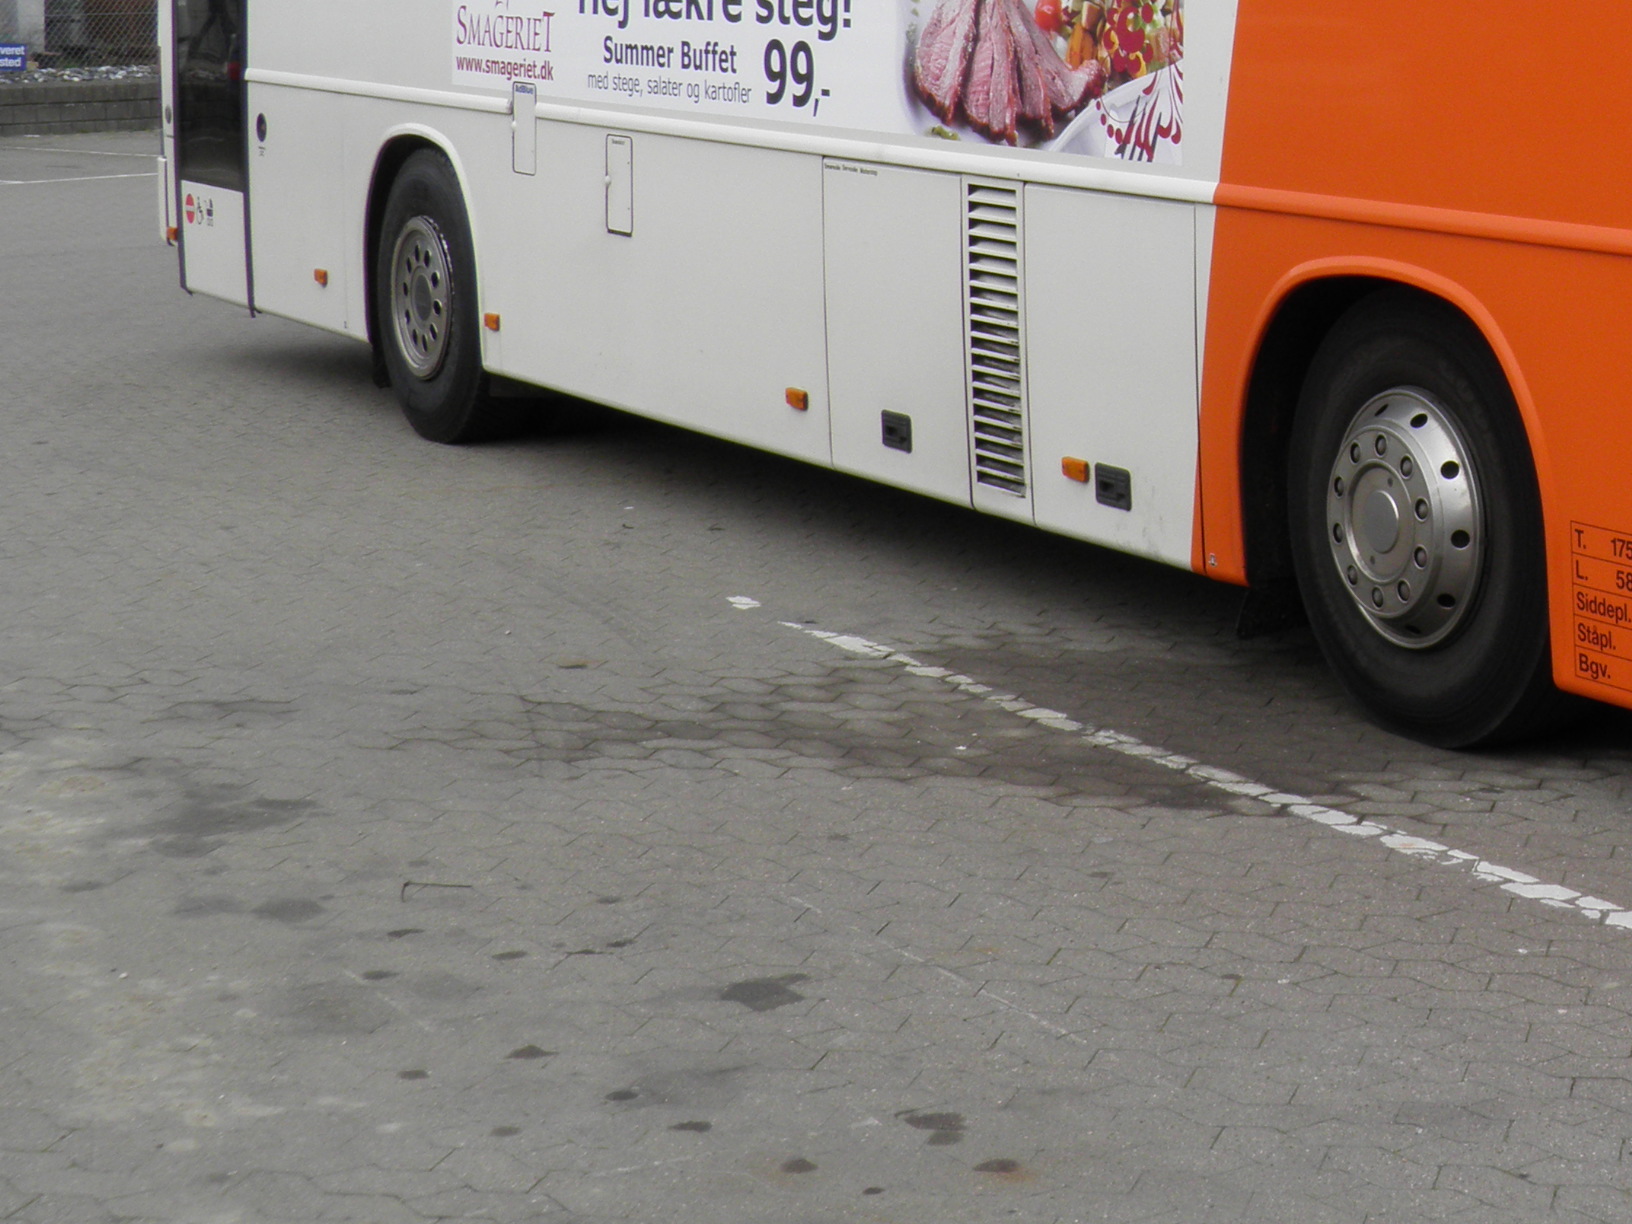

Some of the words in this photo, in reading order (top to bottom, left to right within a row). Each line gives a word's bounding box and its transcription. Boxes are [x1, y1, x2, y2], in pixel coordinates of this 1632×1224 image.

[456, 54, 554, 81] www.smageriet.dk
[603, 35, 674, 69] Summer
[681, 40, 737, 74] Buffet
[588, 71, 609, 90] med
[612, 75, 643, 96] stege,
[647, 77, 682, 97] salater
[686, 83, 700, 103] og
[704, 80, 752, 103] kartofler
[763, 38, 831, 117] 99,-
[1574, 529, 1586, 549] T.
[1575, 559, 1588, 580] L.
[1576, 591, 1631, 624] Siddepl.
[1577, 623, 1616, 651] Ståpl.
[1578, 653, 1611, 679] Bgv.
